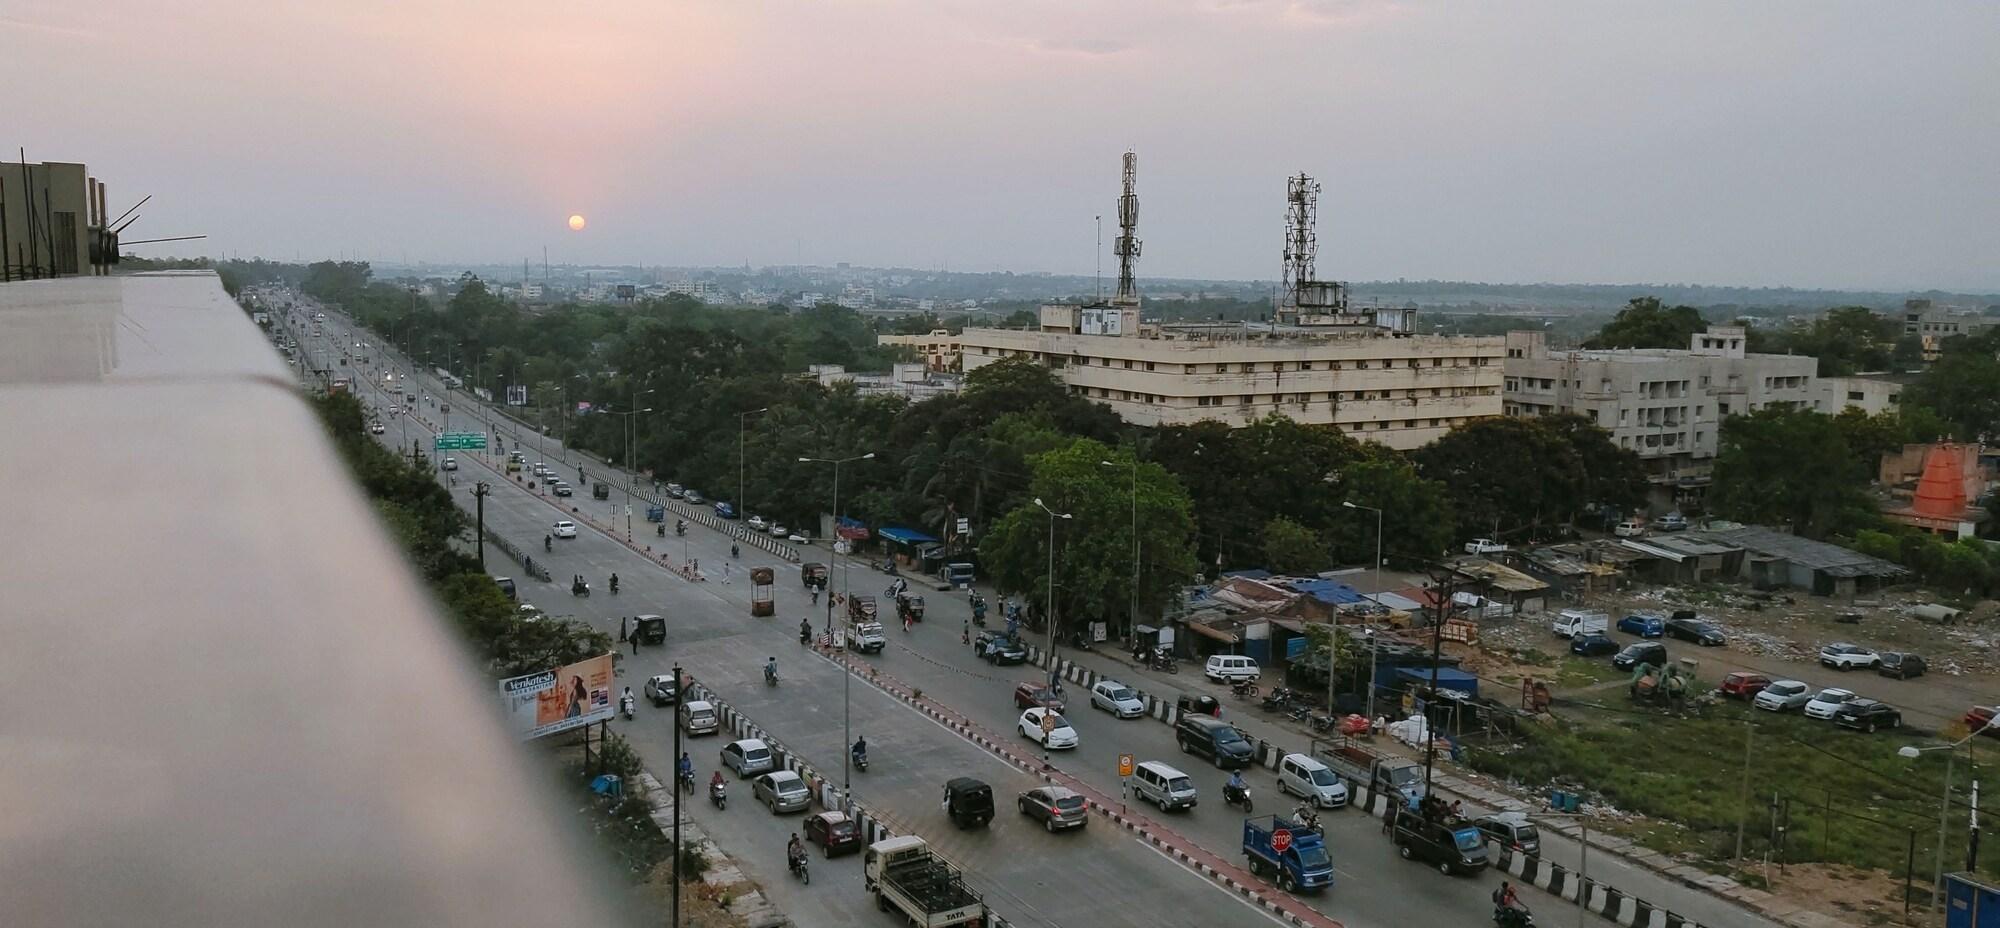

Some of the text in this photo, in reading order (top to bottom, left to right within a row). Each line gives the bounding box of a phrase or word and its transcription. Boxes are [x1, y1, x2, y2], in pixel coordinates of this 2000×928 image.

[510, 672, 554, 690] Venkatesh
[1273, 835, 1290, 846] STOP
[946, 911, 965, 920] TATA
